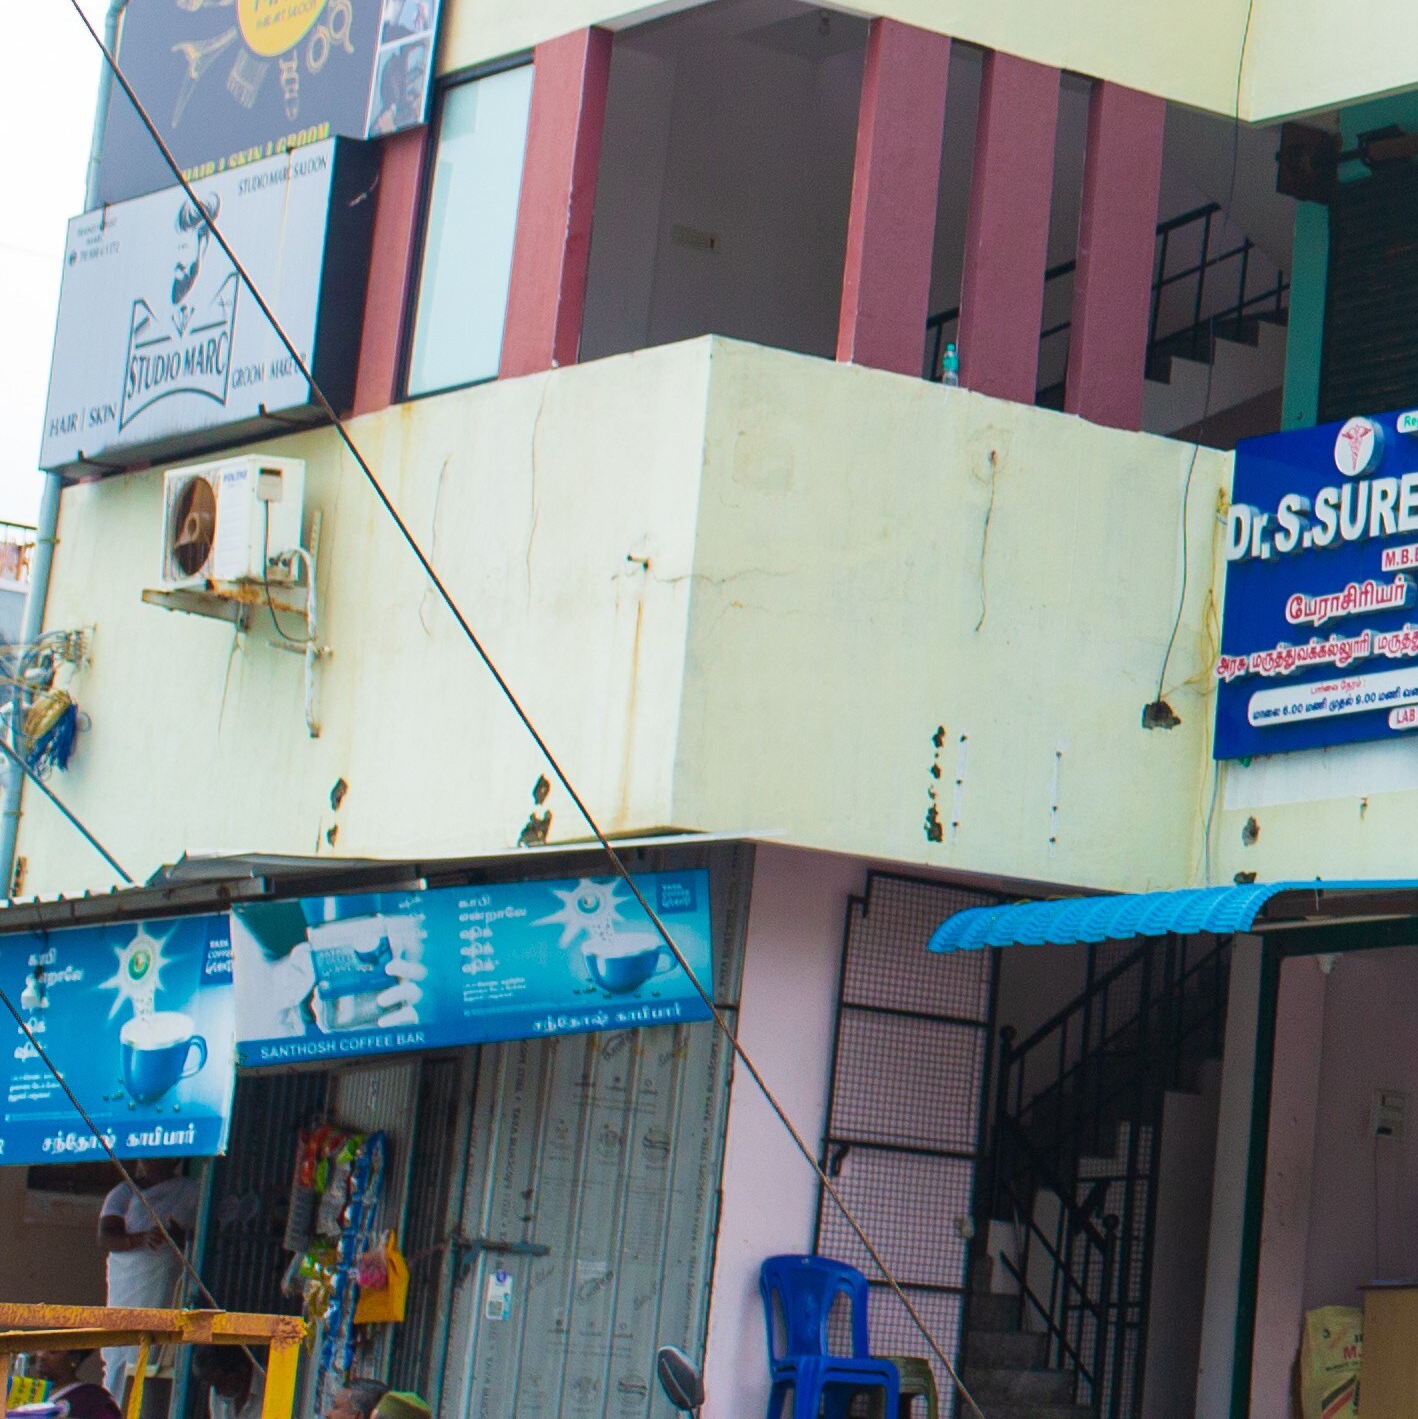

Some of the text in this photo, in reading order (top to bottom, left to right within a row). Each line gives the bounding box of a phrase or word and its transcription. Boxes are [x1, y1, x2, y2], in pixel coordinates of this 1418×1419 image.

[127, 331, 229, 400] STUDIO MARC
[50, 402, 118, 437] HAIR SKIN
[1288, 574, 1407, 623] பேராசிரியர்
[1252, 708, 1281, 721] மாலை
[1282, 704, 1304, 716] 6.00
[1305, 698, 1327, 713] மணி
[1355, 691, 1376, 704] 9.00
[1378, 687, 1401, 701] மணி
[1396, 707, 1416, 724] LAB
[260, 1031, 426, 1060] SANTHOSH COFFEE BAR
